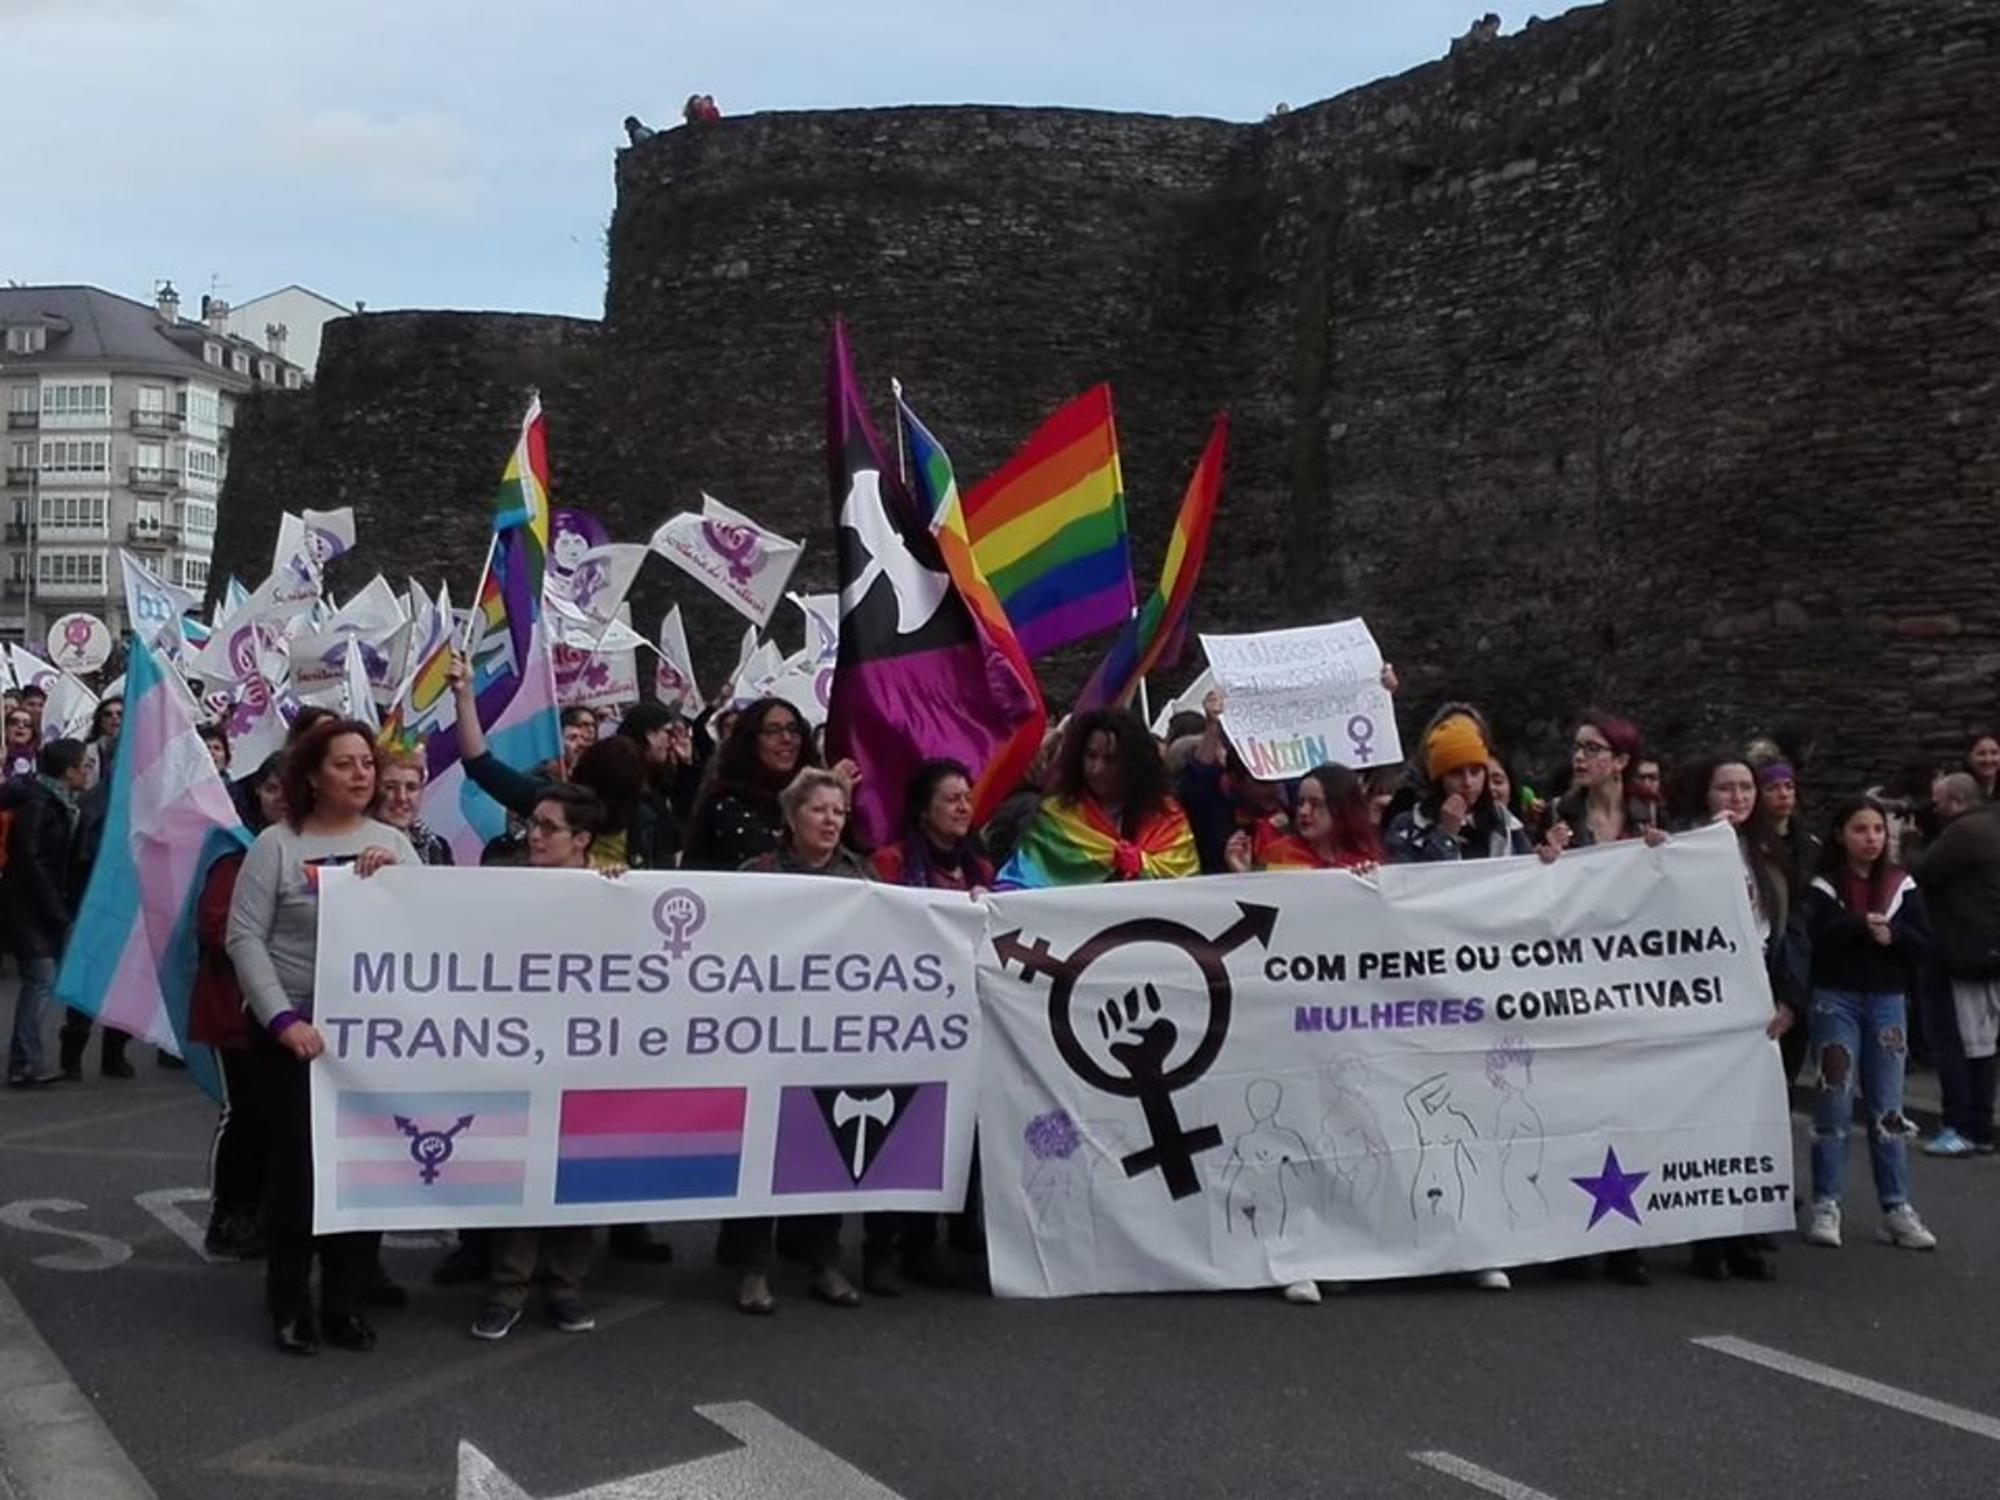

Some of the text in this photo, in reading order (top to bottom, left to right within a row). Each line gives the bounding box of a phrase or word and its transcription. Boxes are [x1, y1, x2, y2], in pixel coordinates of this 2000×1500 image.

[1264, 926, 1737, 982] COM PENE OU COM VAGINA,
[353, 952, 956, 998] MULLERES GALEGAS,
[1295, 997, 1485, 1032] MULHERES
[325, 1014, 969, 1065] TRANS, BI e BOLLERAS
[1662, 1156, 1774, 1182] MULHERES
[1647, 1184, 1790, 1212] AVANTE LGBT
